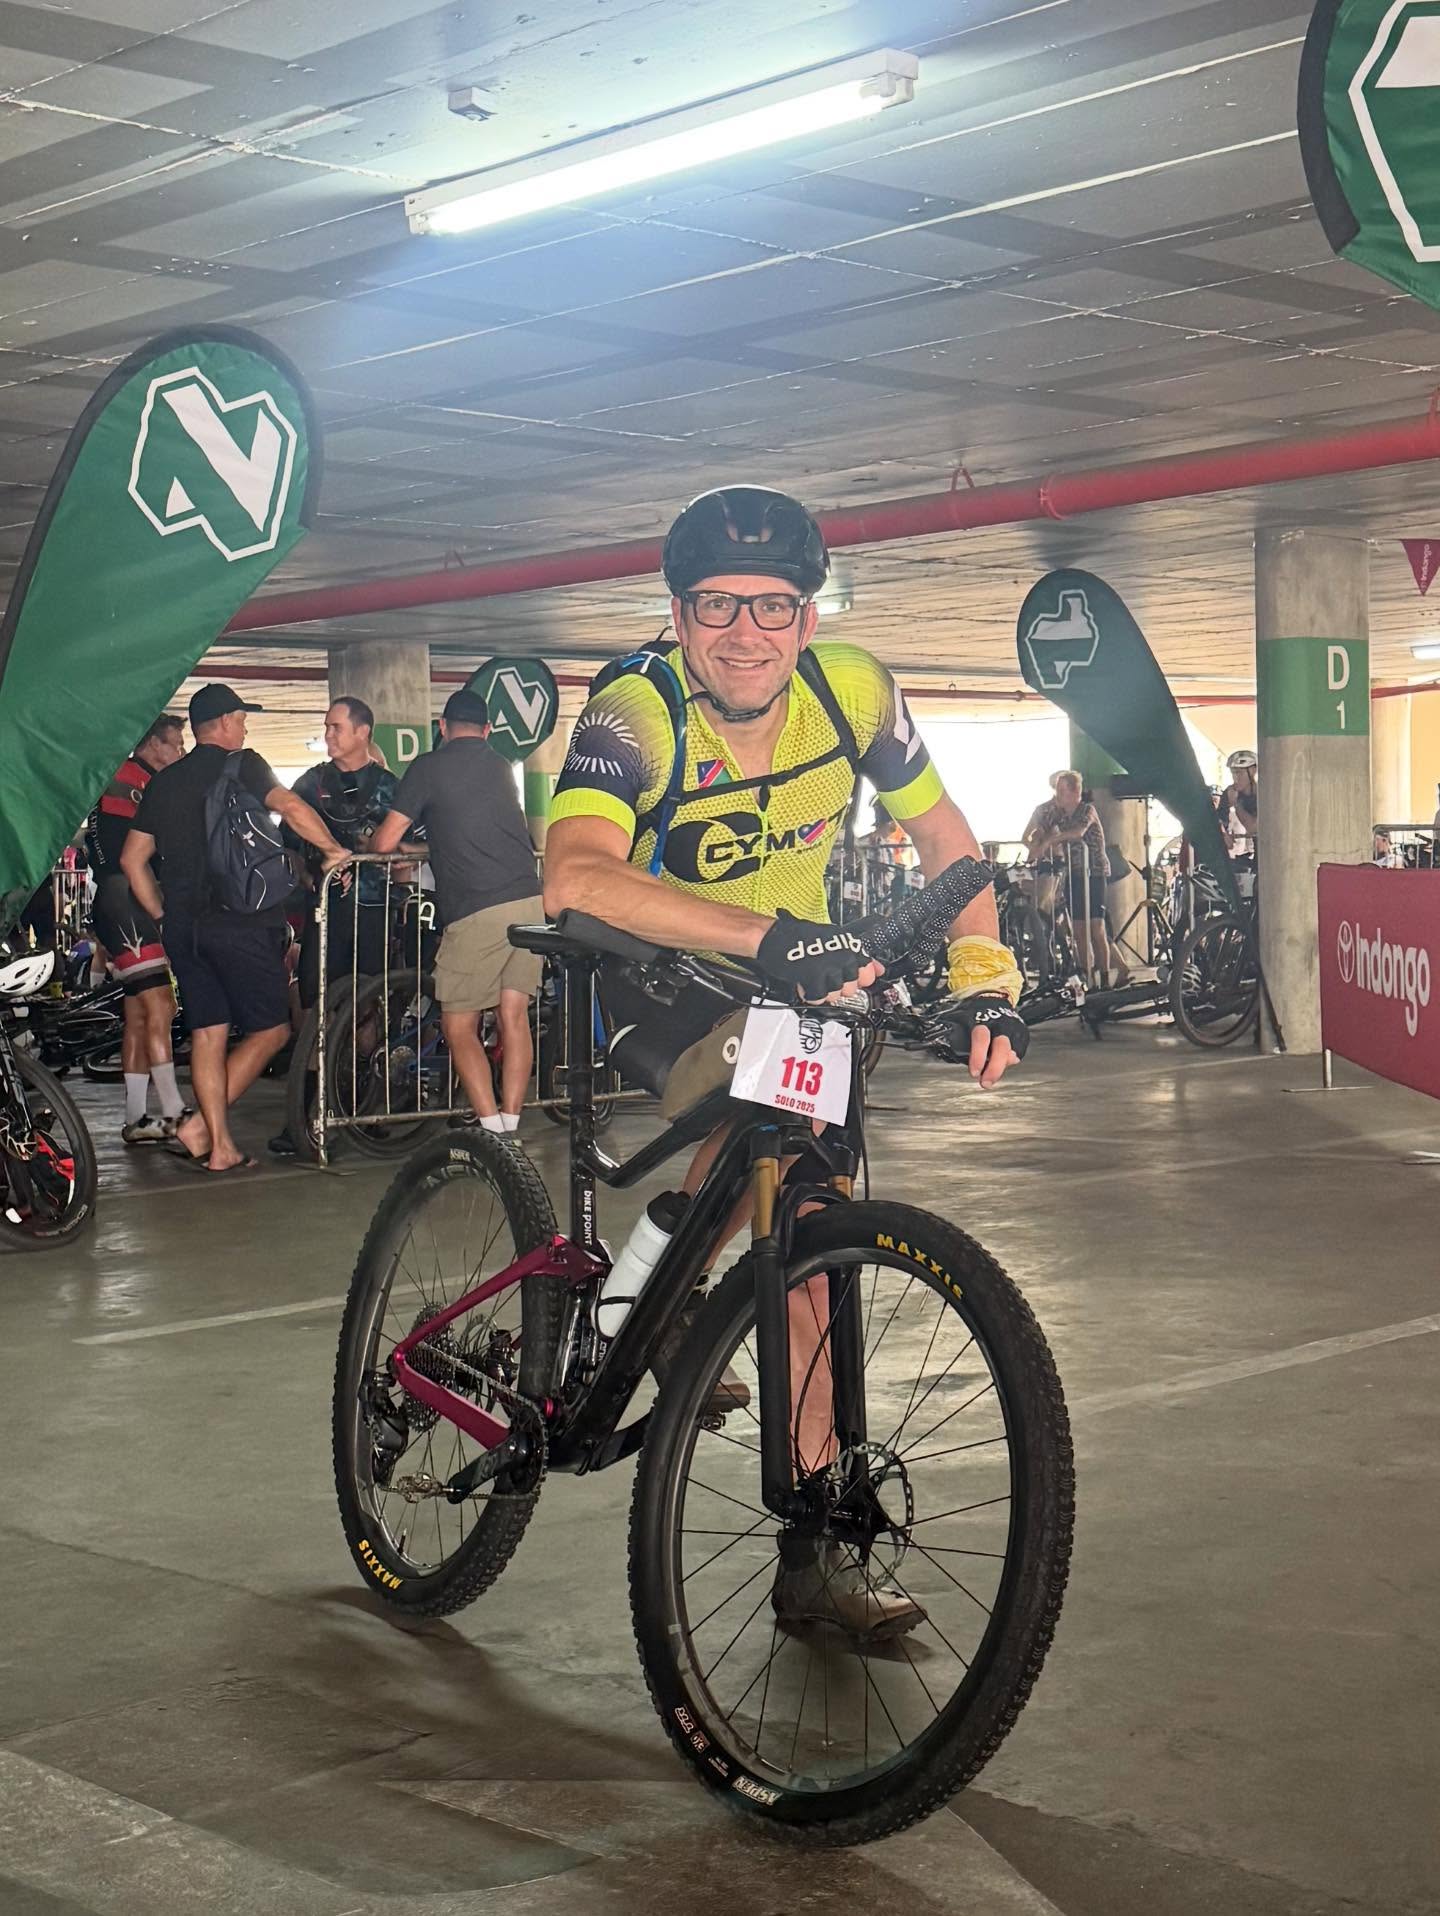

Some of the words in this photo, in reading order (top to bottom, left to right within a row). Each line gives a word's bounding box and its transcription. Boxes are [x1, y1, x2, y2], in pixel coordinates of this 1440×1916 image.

[1327, 645, 1350, 690] D
[1337, 700, 1346, 730] 1
[396, 728, 419, 762] D
[1355, 922, 1431, 1037] Indongo
[781, 1056, 824, 1096] 113
[774, 1094, 795, 1108] SOLO
[796, 1099, 816, 1113] 2025
[877, 1233, 963, 1300] MAXXIS
[358, 1539, 404, 1590] MAXXIS
